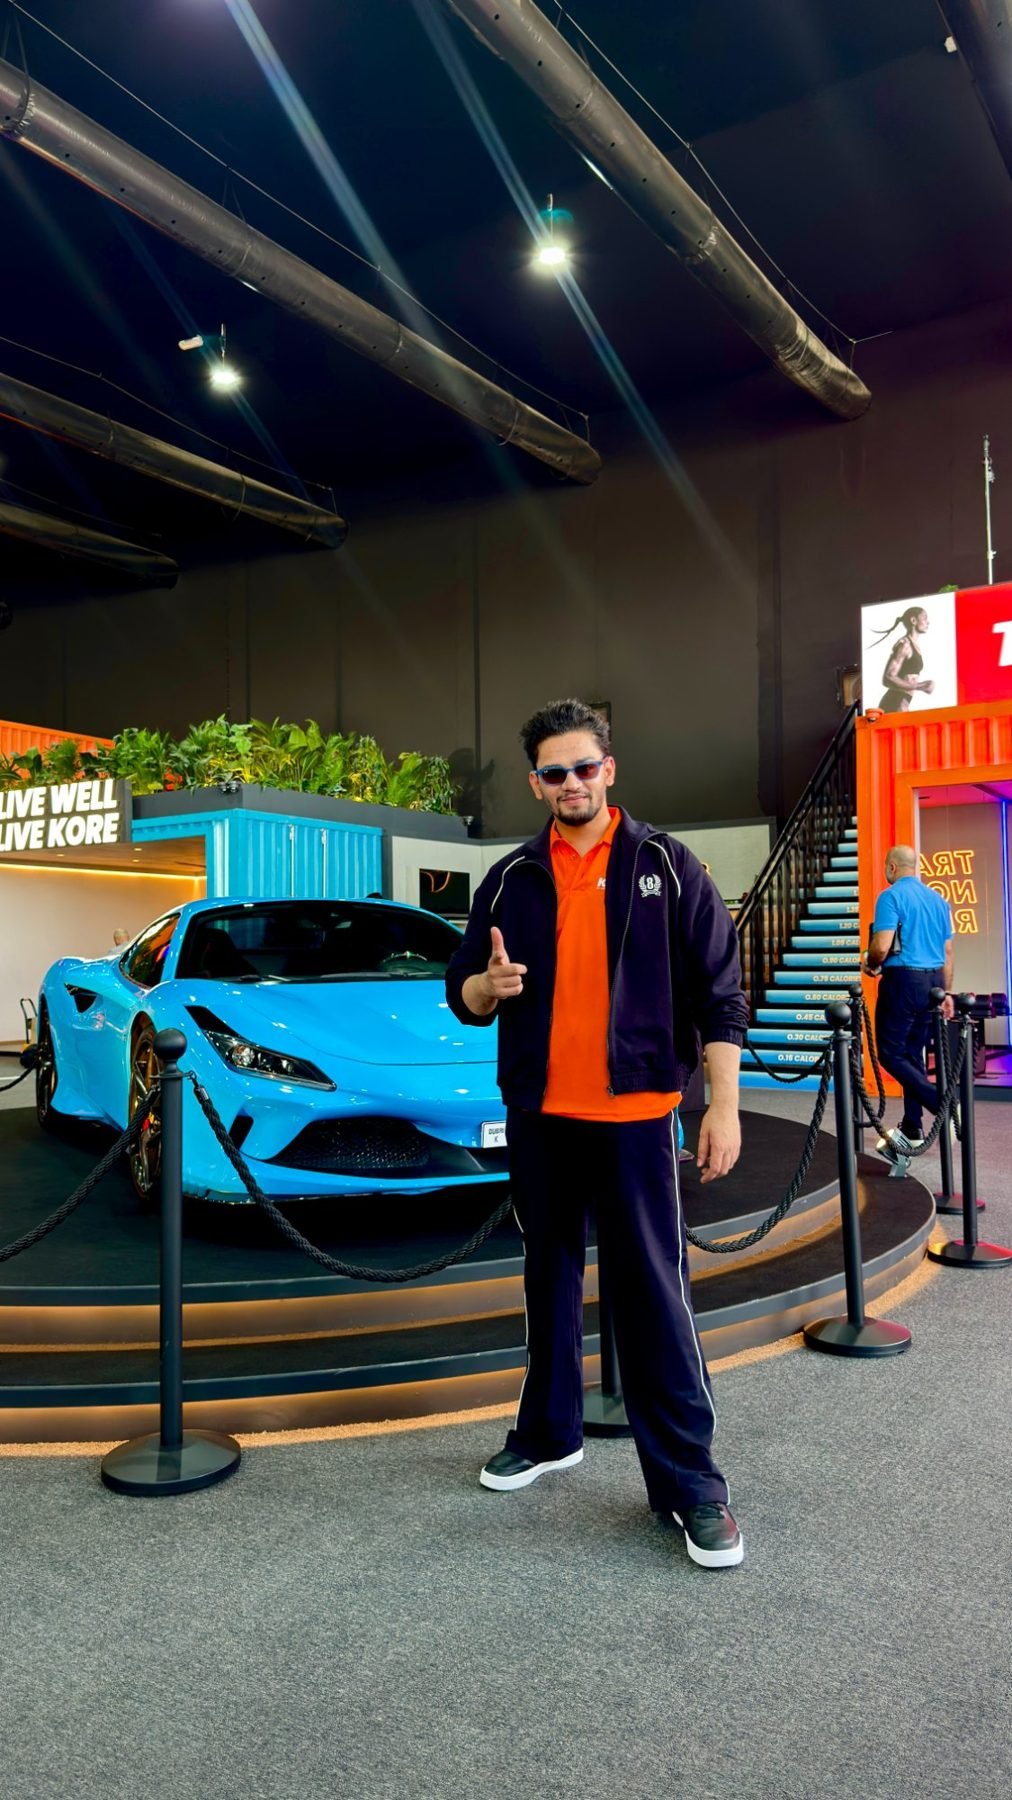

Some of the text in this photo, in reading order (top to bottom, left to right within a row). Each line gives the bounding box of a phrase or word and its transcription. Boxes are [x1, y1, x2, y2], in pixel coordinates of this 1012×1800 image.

[0, 779, 117, 820] LIVE WELL
[0, 813, 119, 851] LIVE KORE
[646, 877, 654, 890] 8
